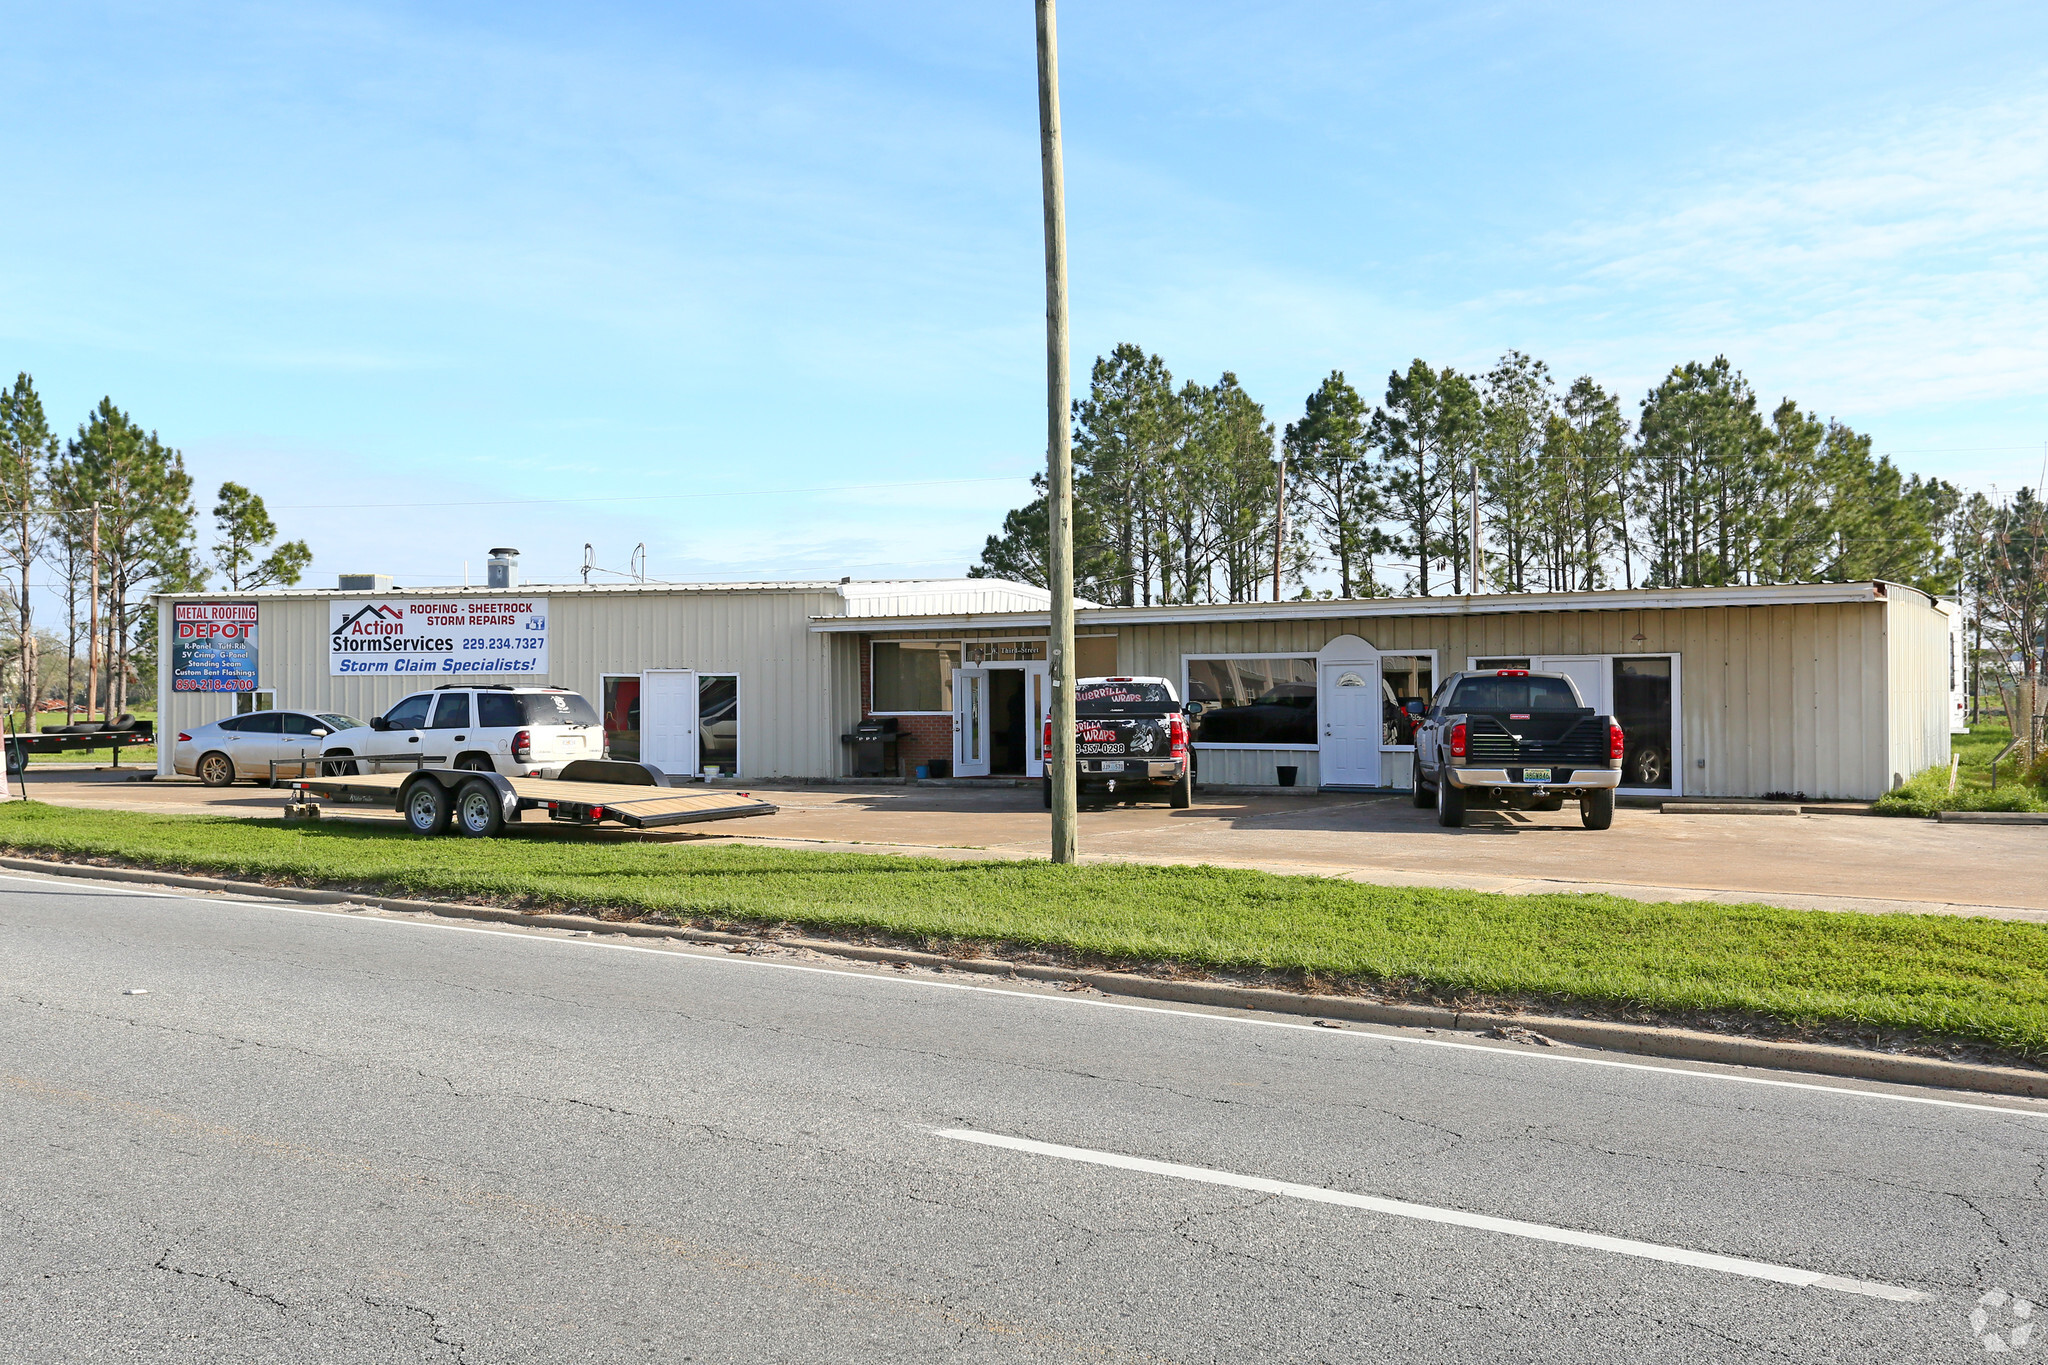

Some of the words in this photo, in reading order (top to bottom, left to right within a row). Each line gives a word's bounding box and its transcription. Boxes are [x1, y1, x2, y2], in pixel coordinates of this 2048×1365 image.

[177, 607, 208, 620] METAL
[212, 607, 256, 620] ROOFING
[410, 604, 458, 614] ROOFING
[468, 603, 533, 614] SHEETROCK
[427, 616, 465, 626] STORM
[469, 615, 516, 626] REPAIRS
[179, 623, 254, 638] DEPOT
[351, 620, 404, 635] Action
[332, 636, 454, 652] StormServices
[462, 637, 545, 650] 229.234.7327
[194, 652, 216, 660] Crimp
[188, 660, 220, 668] Standing
[339, 659, 389, 672] Storm
[394, 658, 437, 672] Claim
[441, 658, 537, 674] Specialists!
[222, 669, 256, 678] Flashings
[176, 679, 254, 690] 850-218-6700
[1112, 694, 1142, 702] WRAPS
[1083, 729, 1116, 742] WRAPS
